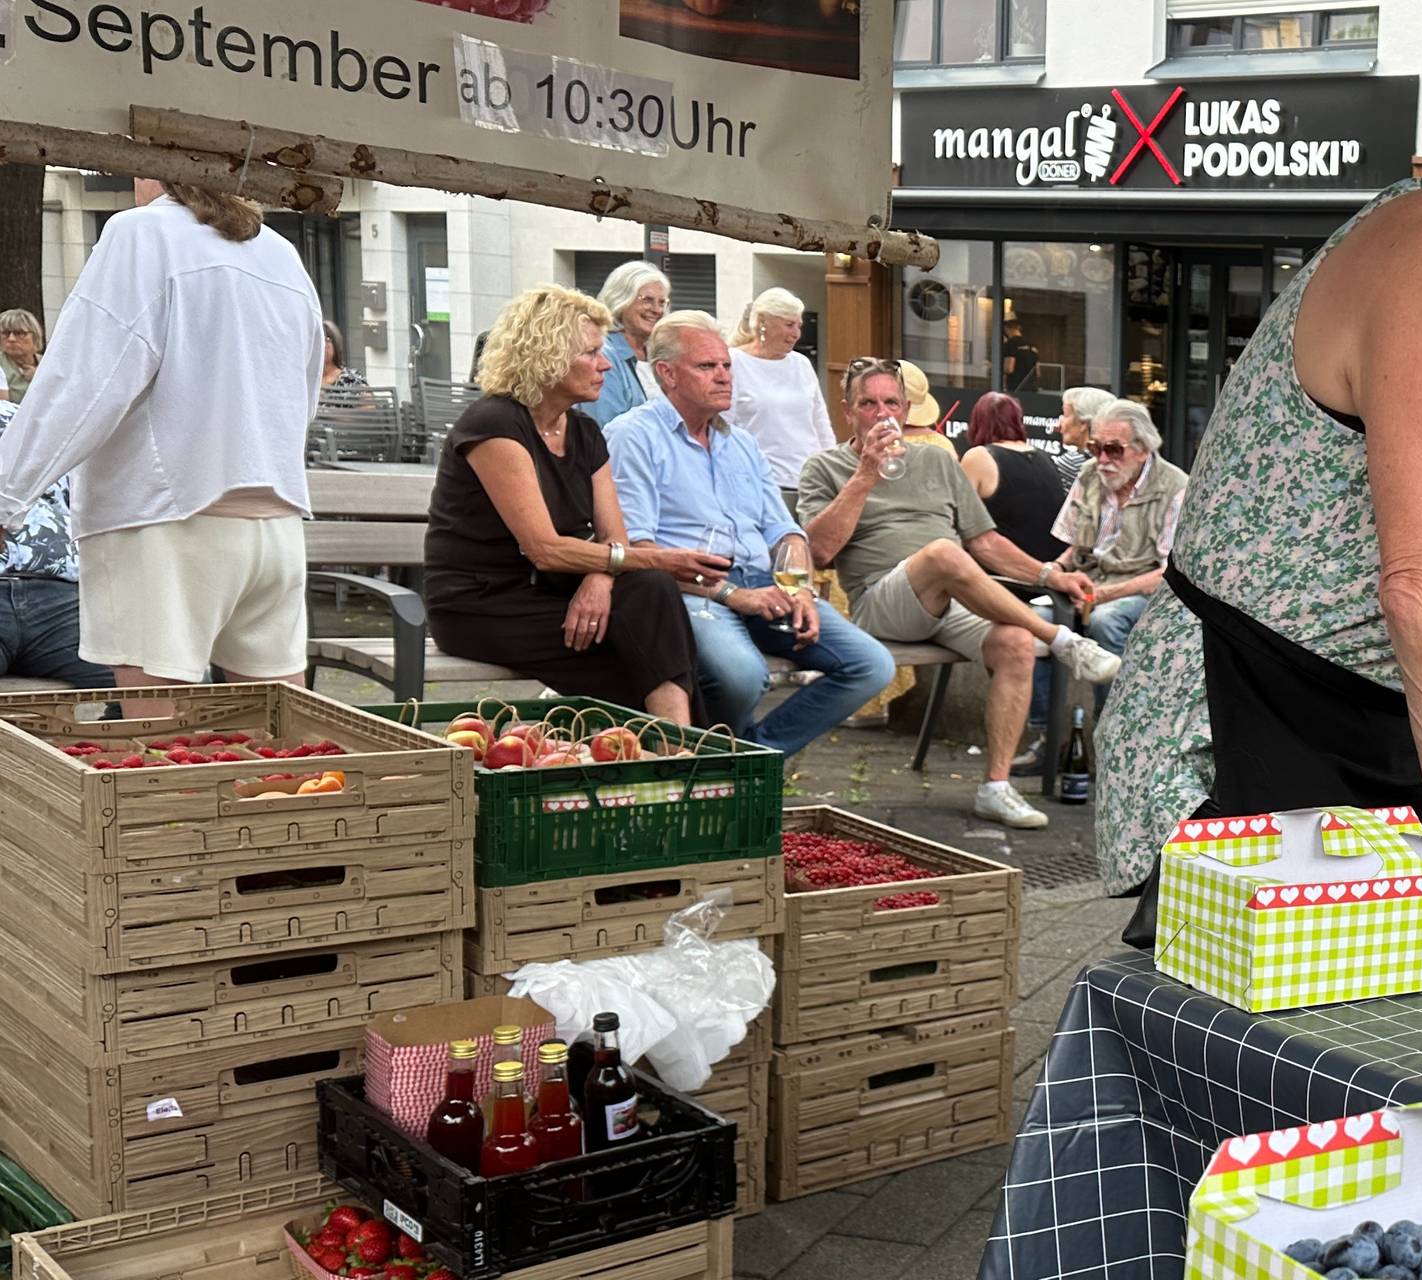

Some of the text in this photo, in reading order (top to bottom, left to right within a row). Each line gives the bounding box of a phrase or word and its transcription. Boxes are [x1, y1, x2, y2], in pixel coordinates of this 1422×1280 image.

[24, 0, 441, 105] September
[458, 62, 512, 111] ab
[1184, 98, 1281, 137] LUKAS
[371, 223, 379, 239] 5
[473, 1229, 486, 1267] LL4310
